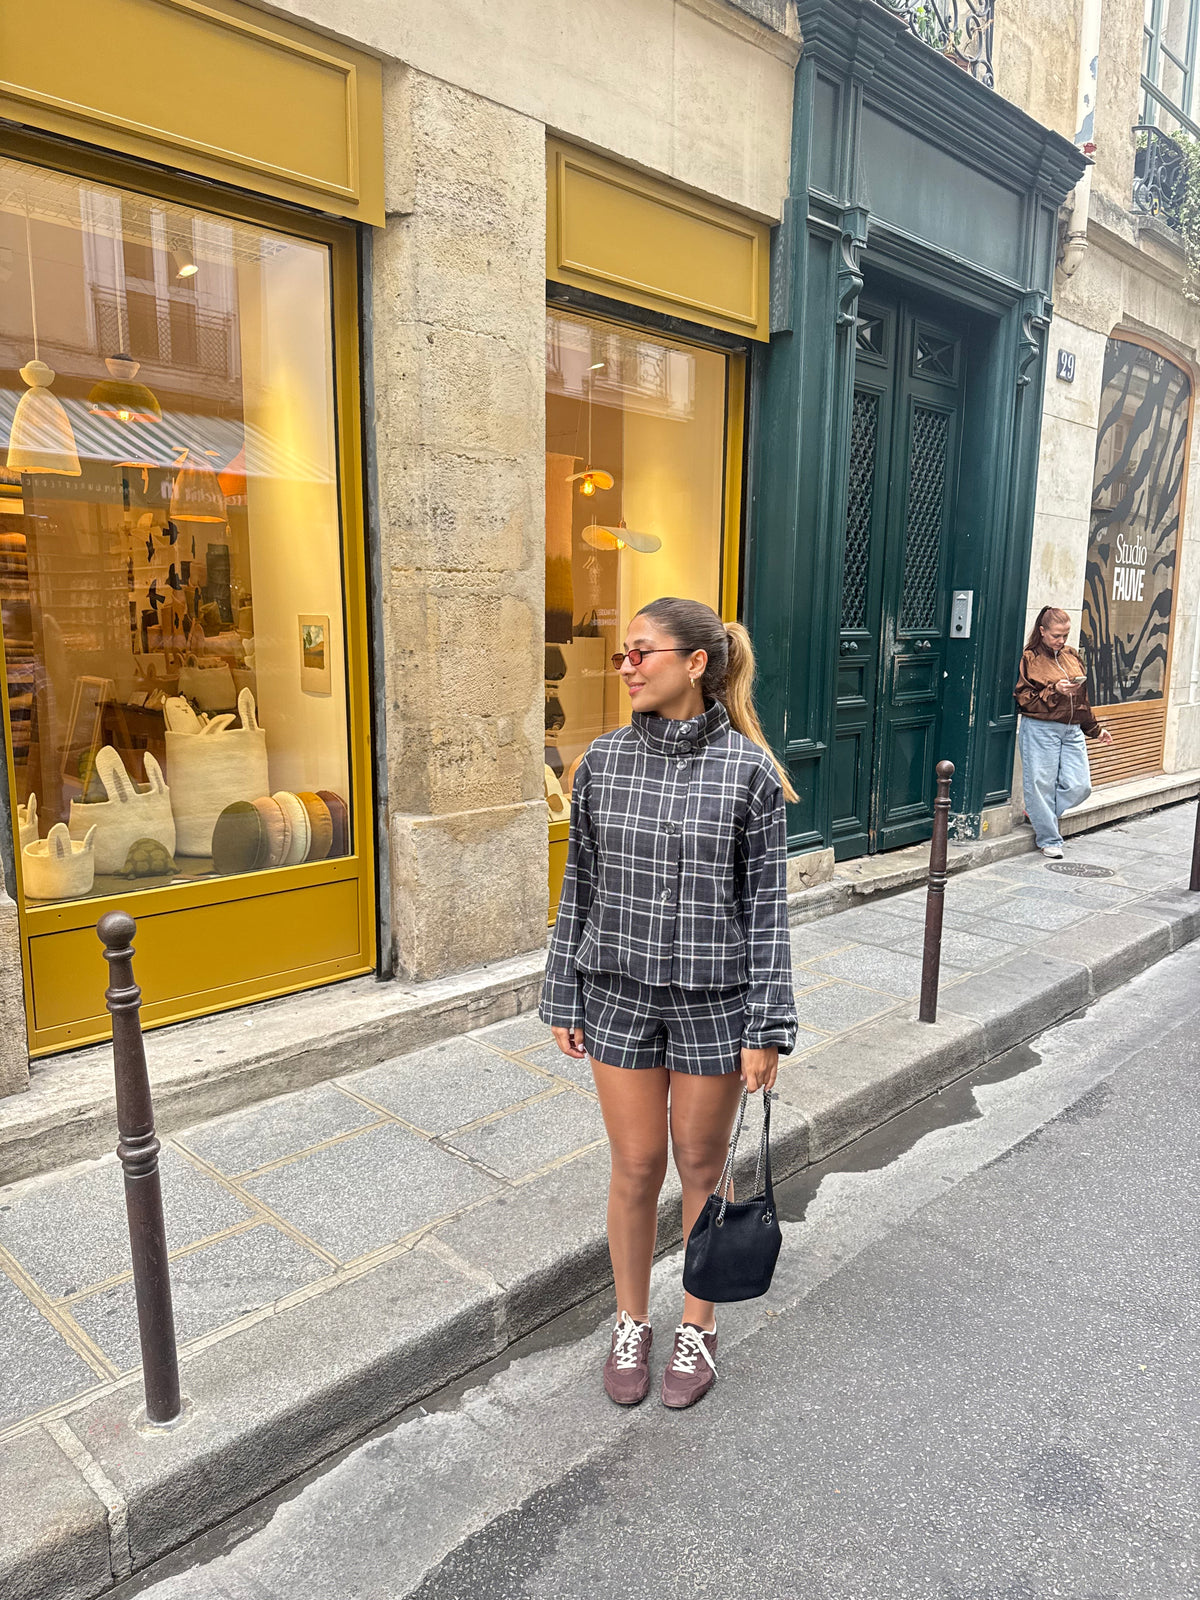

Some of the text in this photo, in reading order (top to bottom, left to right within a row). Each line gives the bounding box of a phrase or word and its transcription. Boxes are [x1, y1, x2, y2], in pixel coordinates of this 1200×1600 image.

[1059, 352, 1074, 379] 29
[1115, 533, 1148, 566] Studio
[1111, 566, 1146, 602] FAUVE
